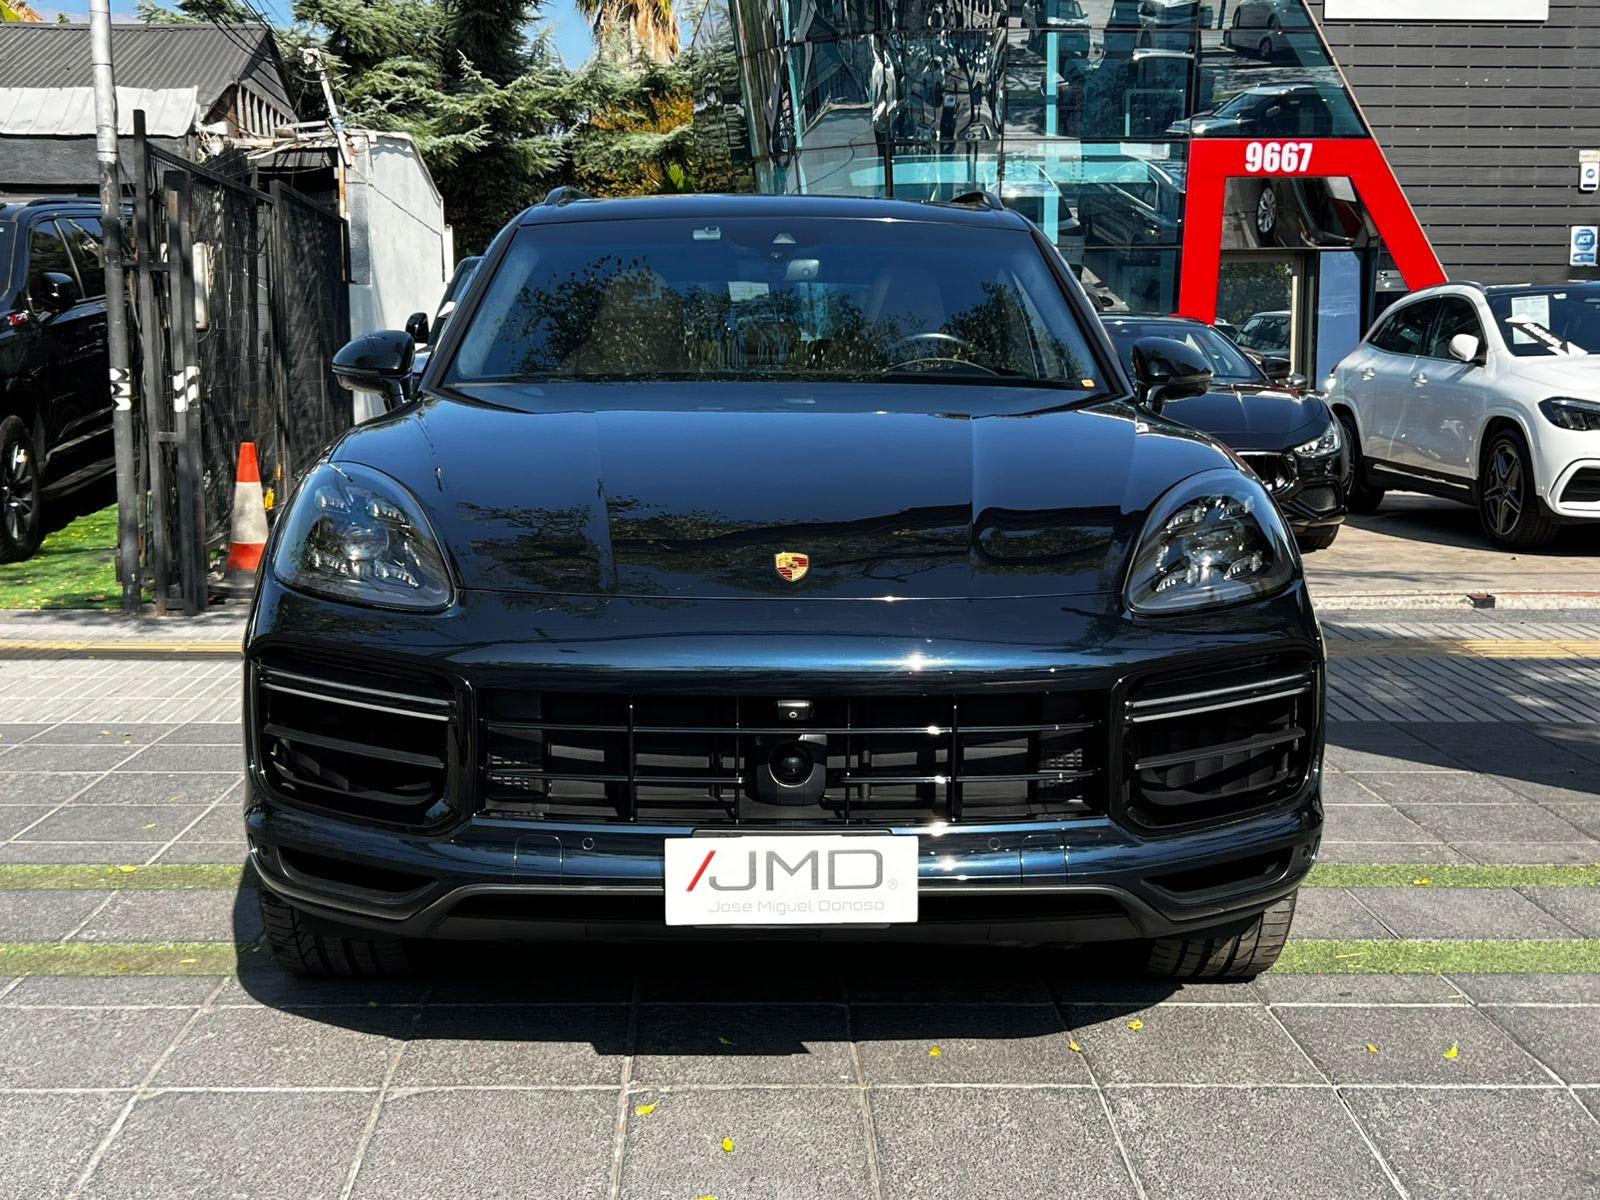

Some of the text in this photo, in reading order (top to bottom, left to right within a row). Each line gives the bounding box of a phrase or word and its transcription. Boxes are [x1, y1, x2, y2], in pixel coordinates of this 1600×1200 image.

[1245, 141, 1313, 173] 9667
[708, 899, 885, 916] Jose Miguel Donoso
